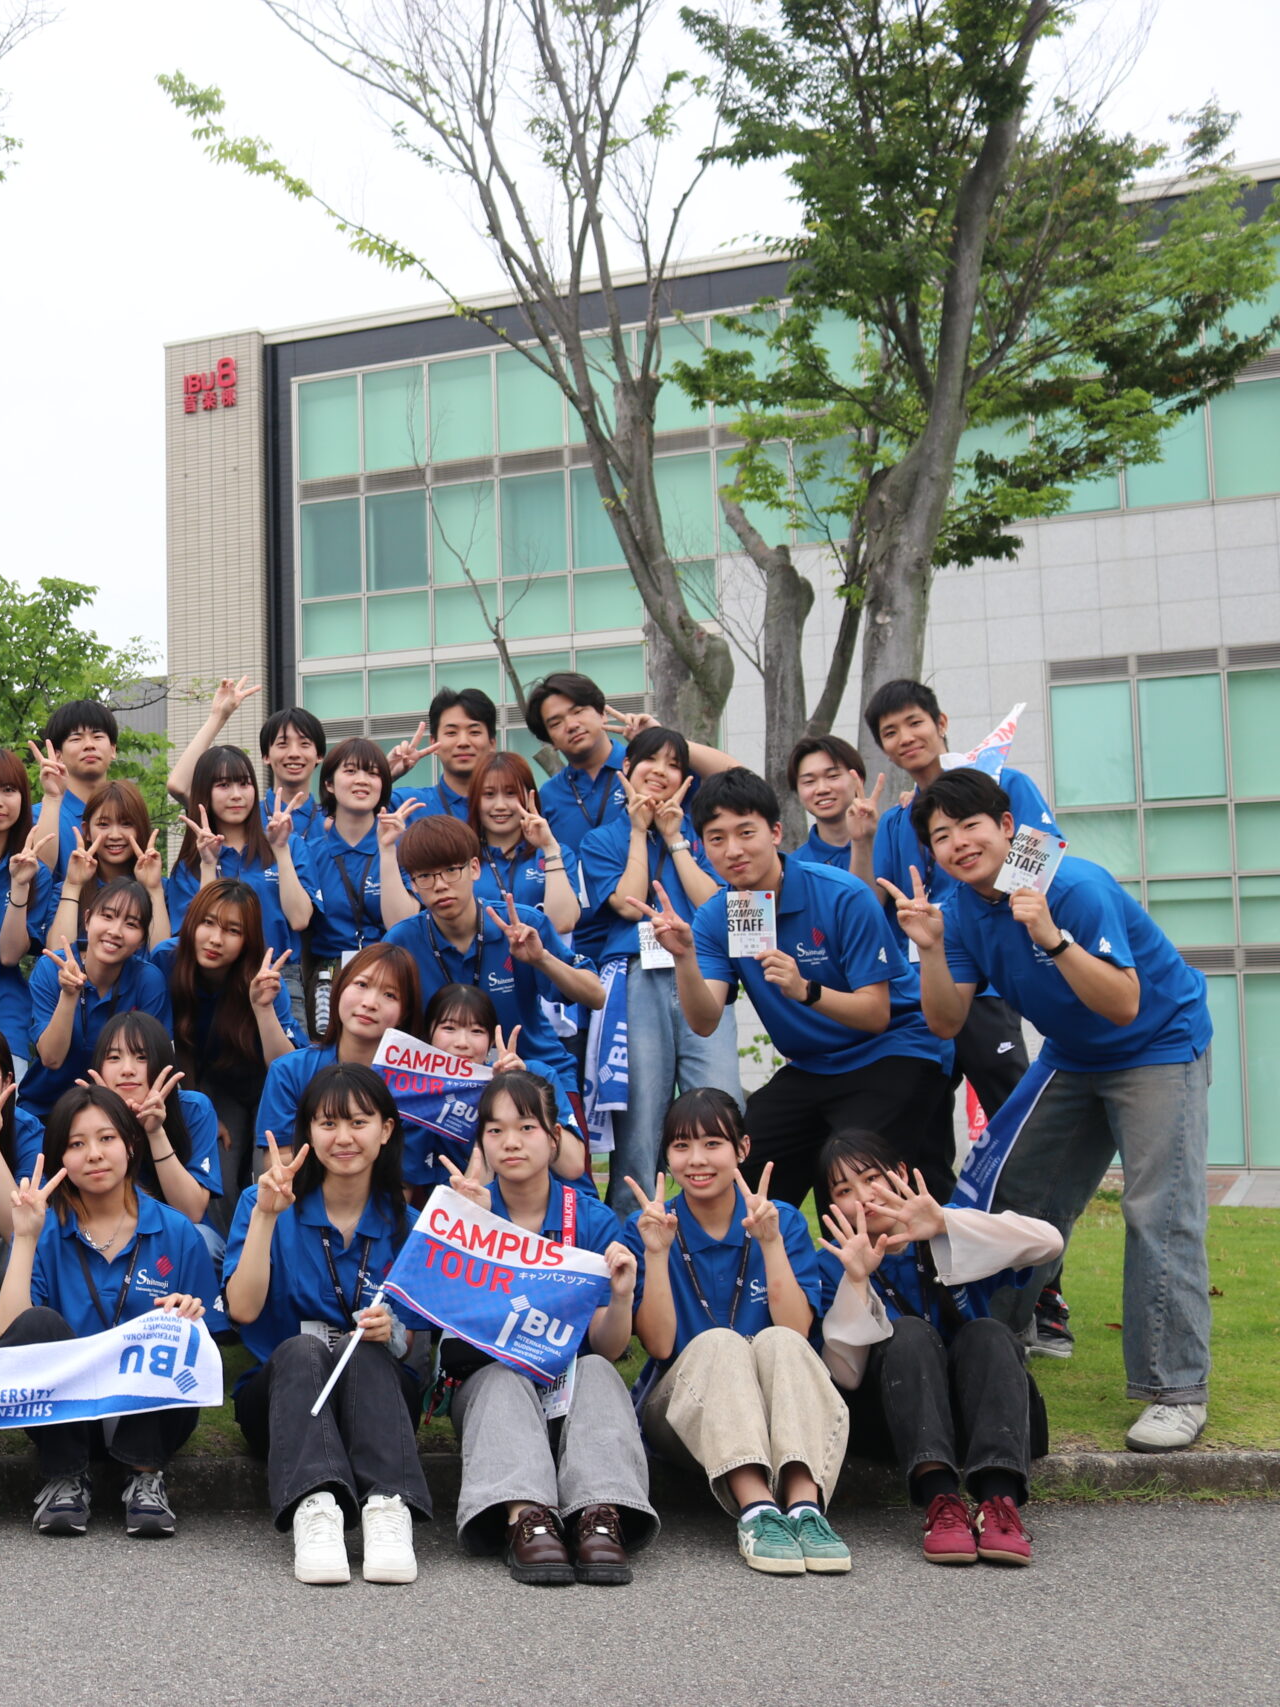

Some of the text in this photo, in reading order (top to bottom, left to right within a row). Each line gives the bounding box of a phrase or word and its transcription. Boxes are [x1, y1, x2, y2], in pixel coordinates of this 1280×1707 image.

[183, 388, 237, 414] 音楽棟
[1014, 832, 1041, 848] OPEN
[1011, 841, 1050, 863] CAMPUS
[1005, 851, 1045, 876] STAFF
[727, 899, 751, 909] OPEN
[727, 908, 764, 918] CAMPUS
[727, 918, 764, 933] STAFF
[385, 1044, 473, 1078] CAMPUS
[383, 1068, 444, 1096] TOUR
[429, 1208, 564, 1267] CAMPUS
[424, 1238, 515, 1294] TOUR
[518, 1271, 597, 1287] キャンパスツアー
[143, 1324, 182, 1333] BUDDHIST
[122, 1333, 180, 1342] INTERNATIONAL
[516, 1334, 562, 1358] INTERNATIONAL
[510, 1346, 546, 1363] UNIVERSITY
[513, 1340, 545, 1355] BUDDHIST
